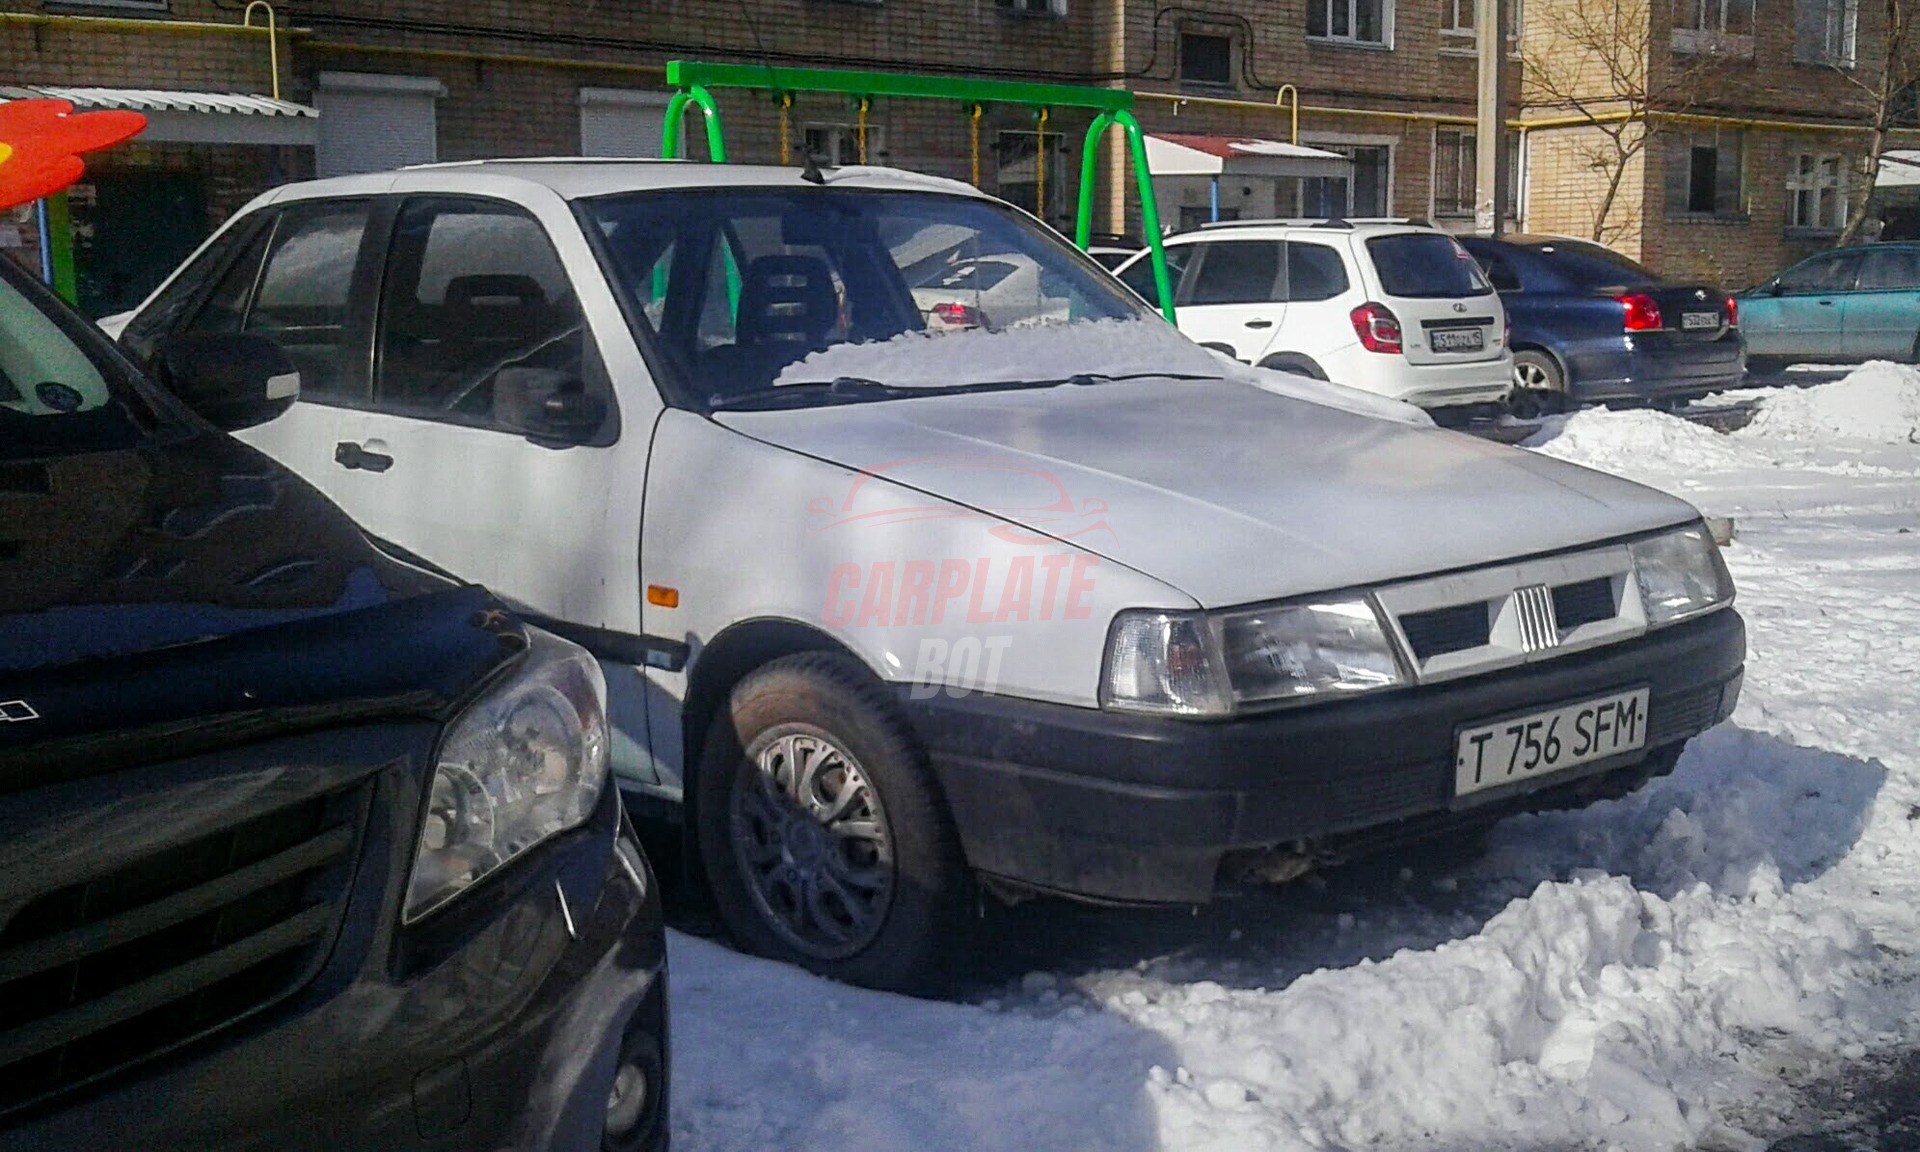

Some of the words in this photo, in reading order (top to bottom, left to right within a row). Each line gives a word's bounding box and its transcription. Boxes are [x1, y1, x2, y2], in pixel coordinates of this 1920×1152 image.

[1469, 732, 1493, 783] T
[1506, 716, 1561, 775] 756
[1572, 697, 1638, 757] SFM
